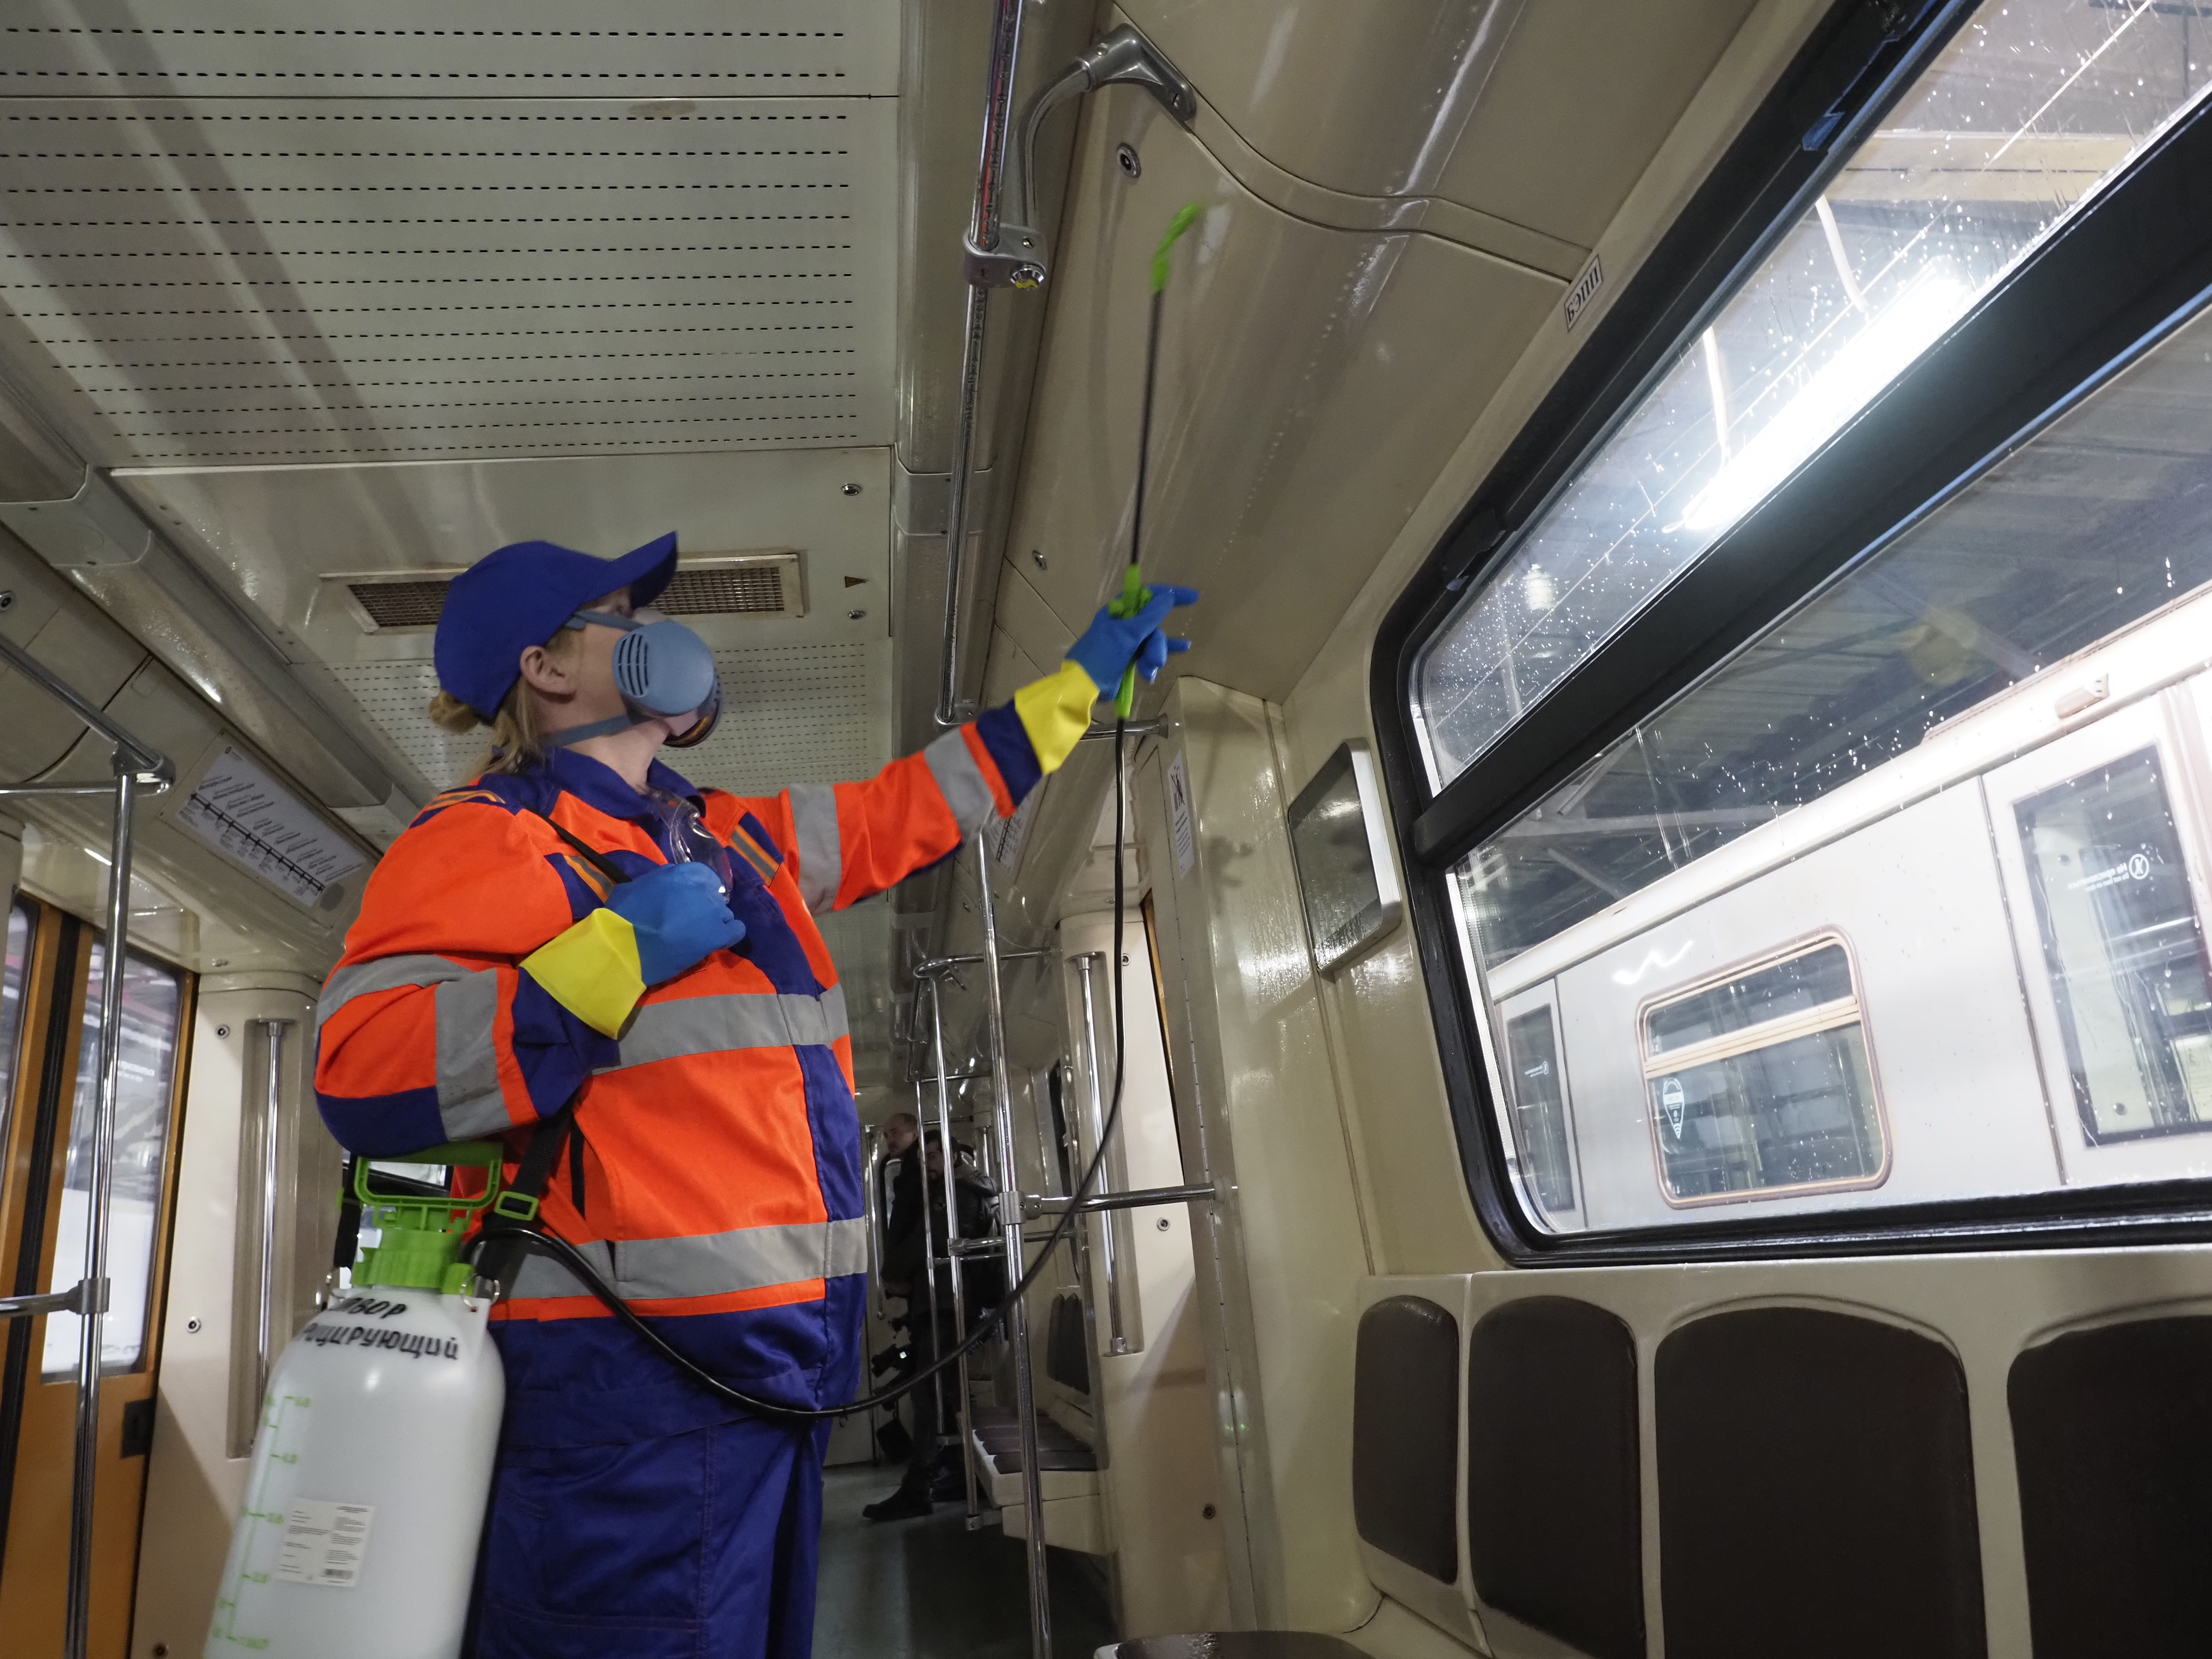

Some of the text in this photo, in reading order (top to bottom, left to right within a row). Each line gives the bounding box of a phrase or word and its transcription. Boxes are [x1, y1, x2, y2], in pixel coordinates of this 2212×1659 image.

[1567, 266, 1598, 322] БЭПП
[333, 1297, 407, 1318] ВОР
[304, 1323, 459, 1360] ЦИРУЮЩИЙ
